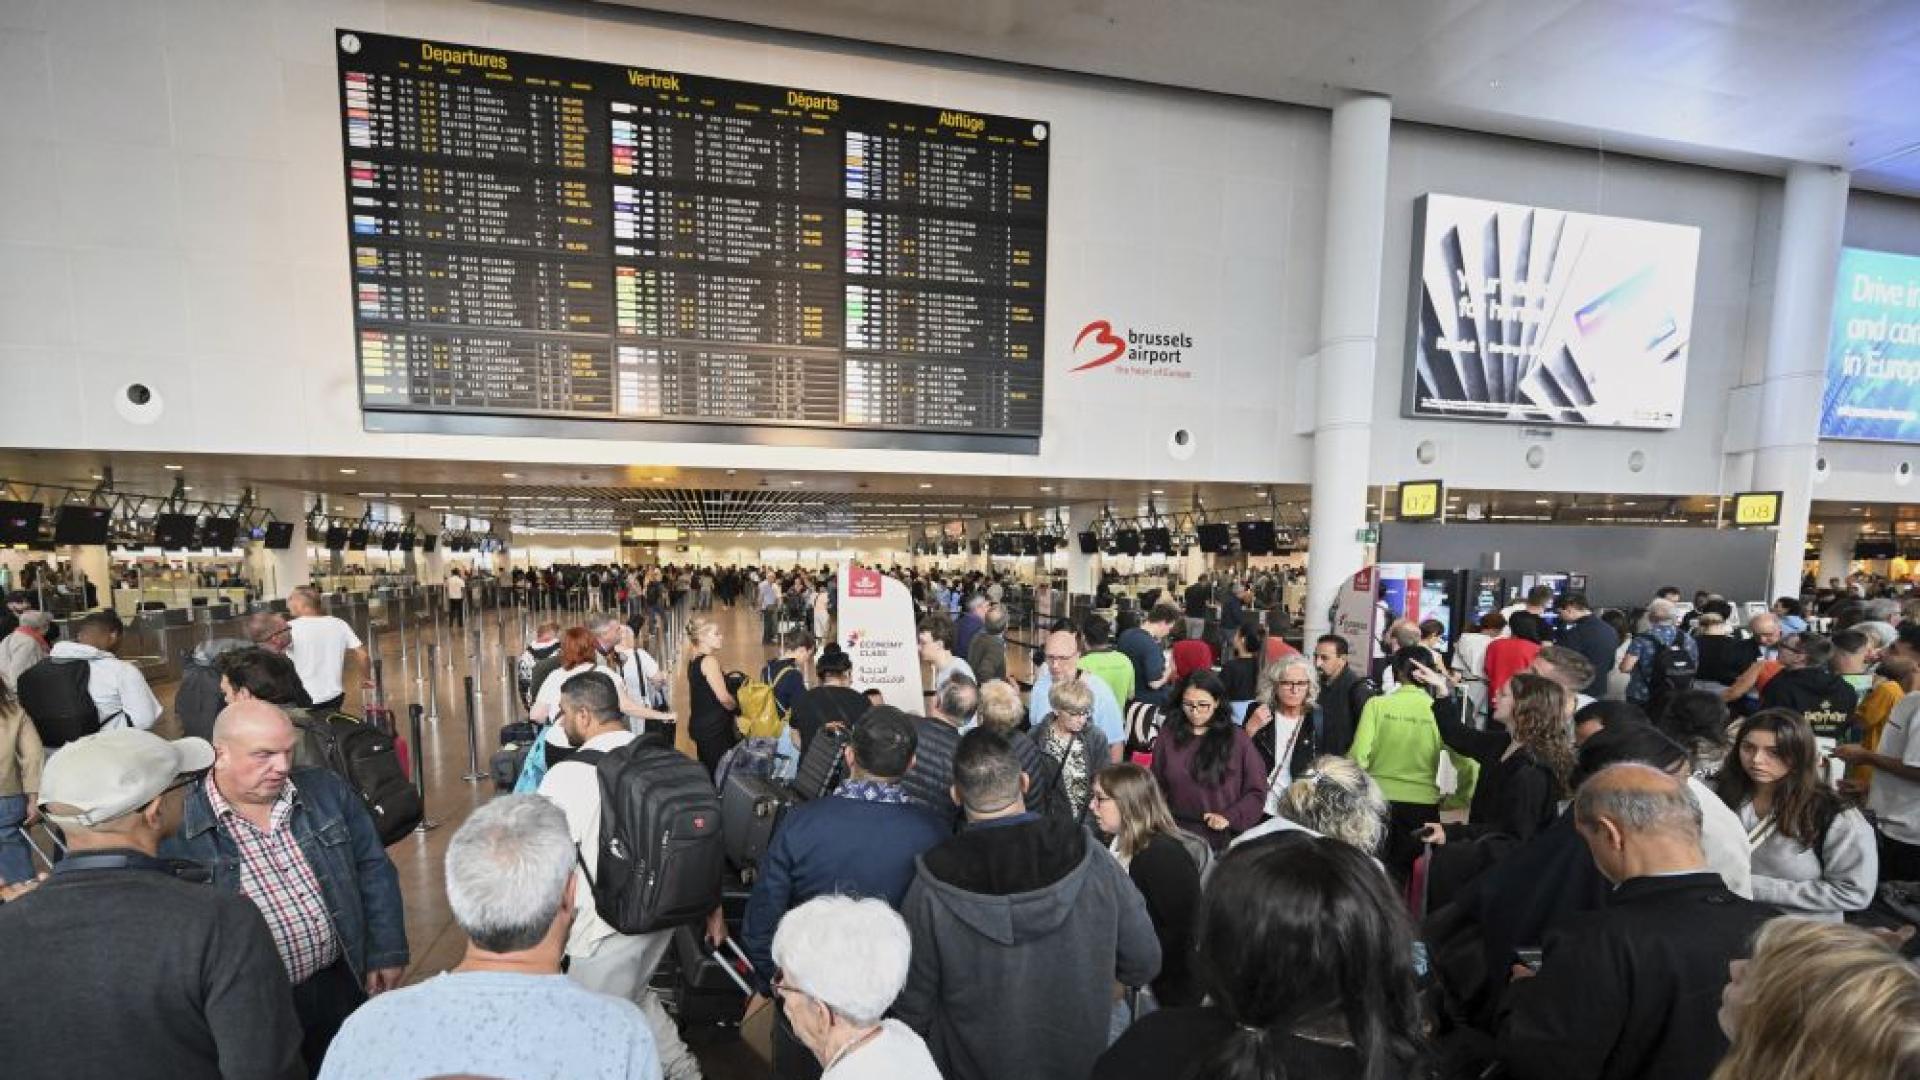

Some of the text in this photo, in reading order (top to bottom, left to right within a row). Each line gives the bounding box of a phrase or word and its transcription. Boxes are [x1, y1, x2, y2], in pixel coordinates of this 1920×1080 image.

[421, 43, 508, 69] Departures
[628, 69, 680, 91] Vertrek
[787, 91, 840, 112] Départs
[938, 111, 986, 132] Abflüge
[1852, 273, 1904, 306] Drive
[1847, 313, 1887, 341] and
[1128, 328, 1193, 348] brussels
[1128, 345, 1182, 365] airport
[1842, 348, 1861, 376] in
[1407, 494, 1432, 511] 07
[1743, 503, 1769, 519] 08
[859, 641, 904, 649] ECONOMY
[859, 649, 888, 657] CLASS
